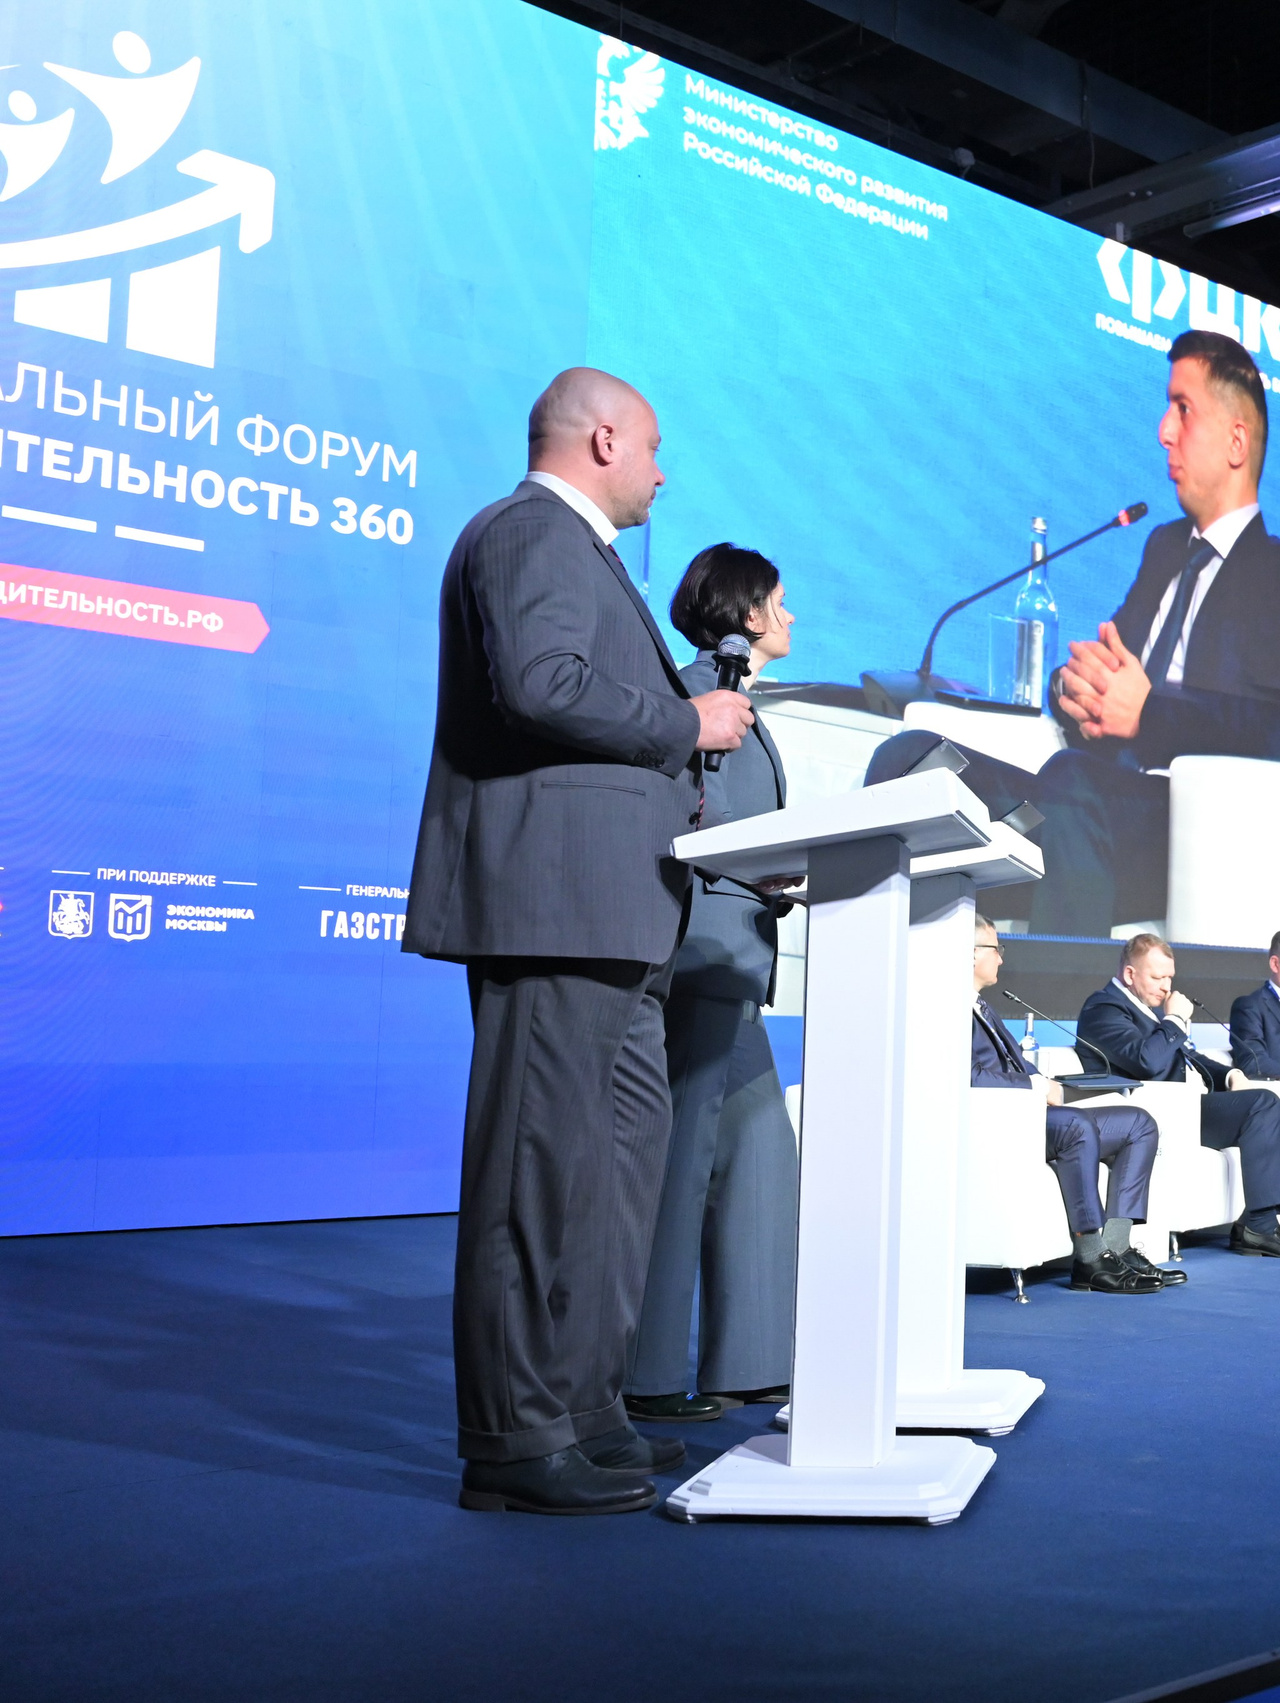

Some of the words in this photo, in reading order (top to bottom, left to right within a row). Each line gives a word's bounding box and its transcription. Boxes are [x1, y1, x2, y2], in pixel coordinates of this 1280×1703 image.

[685, 73, 839, 152] Министерство
[683, 106, 858, 187] экономического
[860, 174, 949, 222] развития
[683, 131, 812, 198] Российской
[815, 182, 929, 241] Федерации
[0, 361, 220, 447] ЛЬНЫЙ
[0, 427, 321, 528] ТЕЛЬНОСТЬ
[330, 496, 415, 546] 360
[236, 413, 419, 488] ФОРУМ
[97, 867, 126, 882] ПРИ
[129, 870, 217, 887] ПОДДЕРЖКЕ
[166, 904, 255, 920] ЭКОНОМИКА
[165, 918, 227, 932] МОСКВЫ
